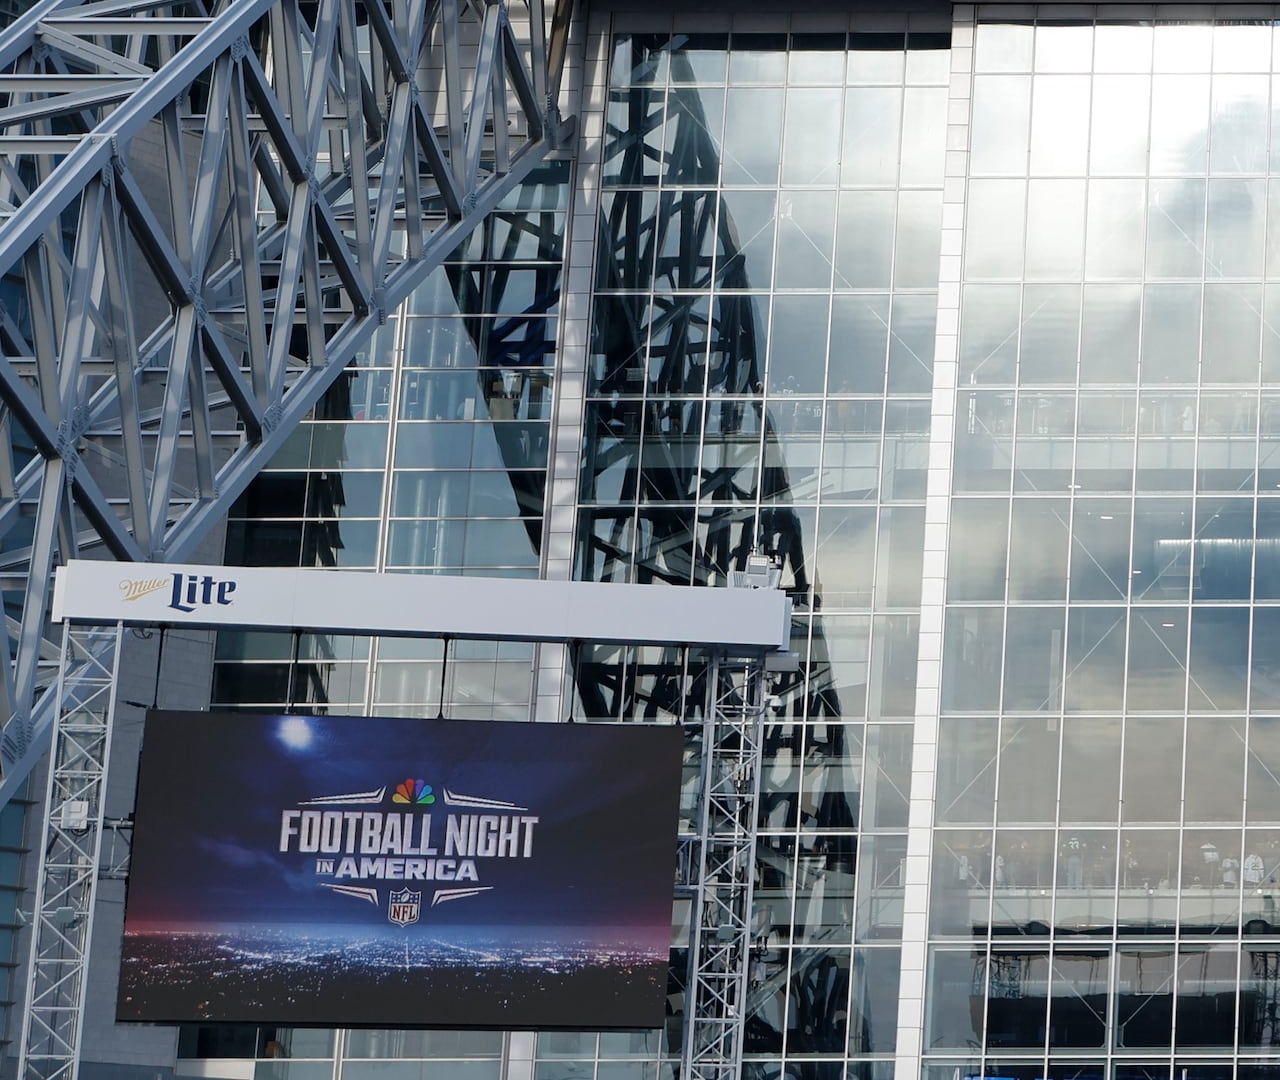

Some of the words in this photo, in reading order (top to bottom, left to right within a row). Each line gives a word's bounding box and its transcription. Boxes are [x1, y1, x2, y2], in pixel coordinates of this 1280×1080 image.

[119, 578, 170, 601] Miller
[168, 573, 237, 613] Lite
[279, 809, 438, 856] FOOTBALL
[444, 814, 539, 858] NIGHT
[316, 860, 334, 874] IN
[335, 857, 480, 882] AMERICA
[391, 904, 416, 920] NFL
